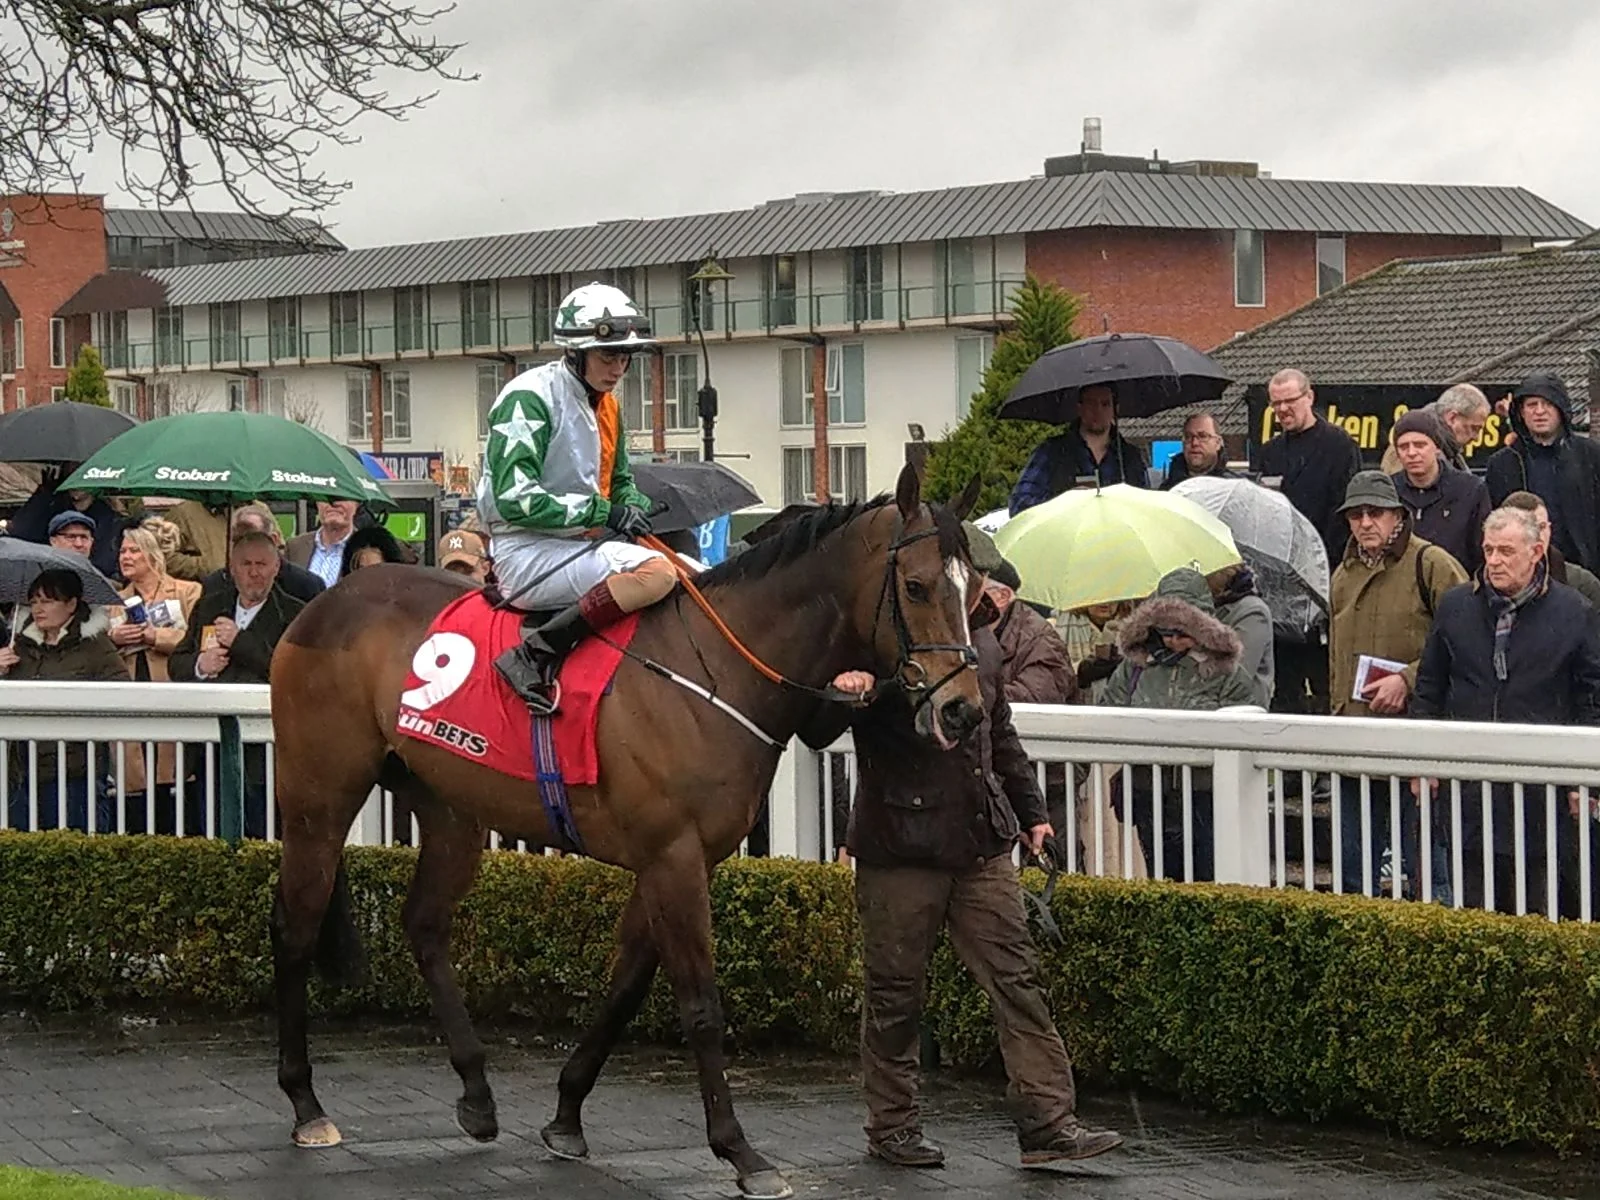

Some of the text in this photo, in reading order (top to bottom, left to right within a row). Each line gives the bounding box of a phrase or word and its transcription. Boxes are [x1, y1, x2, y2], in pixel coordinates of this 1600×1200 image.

[1262, 405, 1379, 449] Cken
[154, 466, 231, 481] Stobart
[272, 470, 336, 487] Stobart
[401, 632, 476, 711] 9
